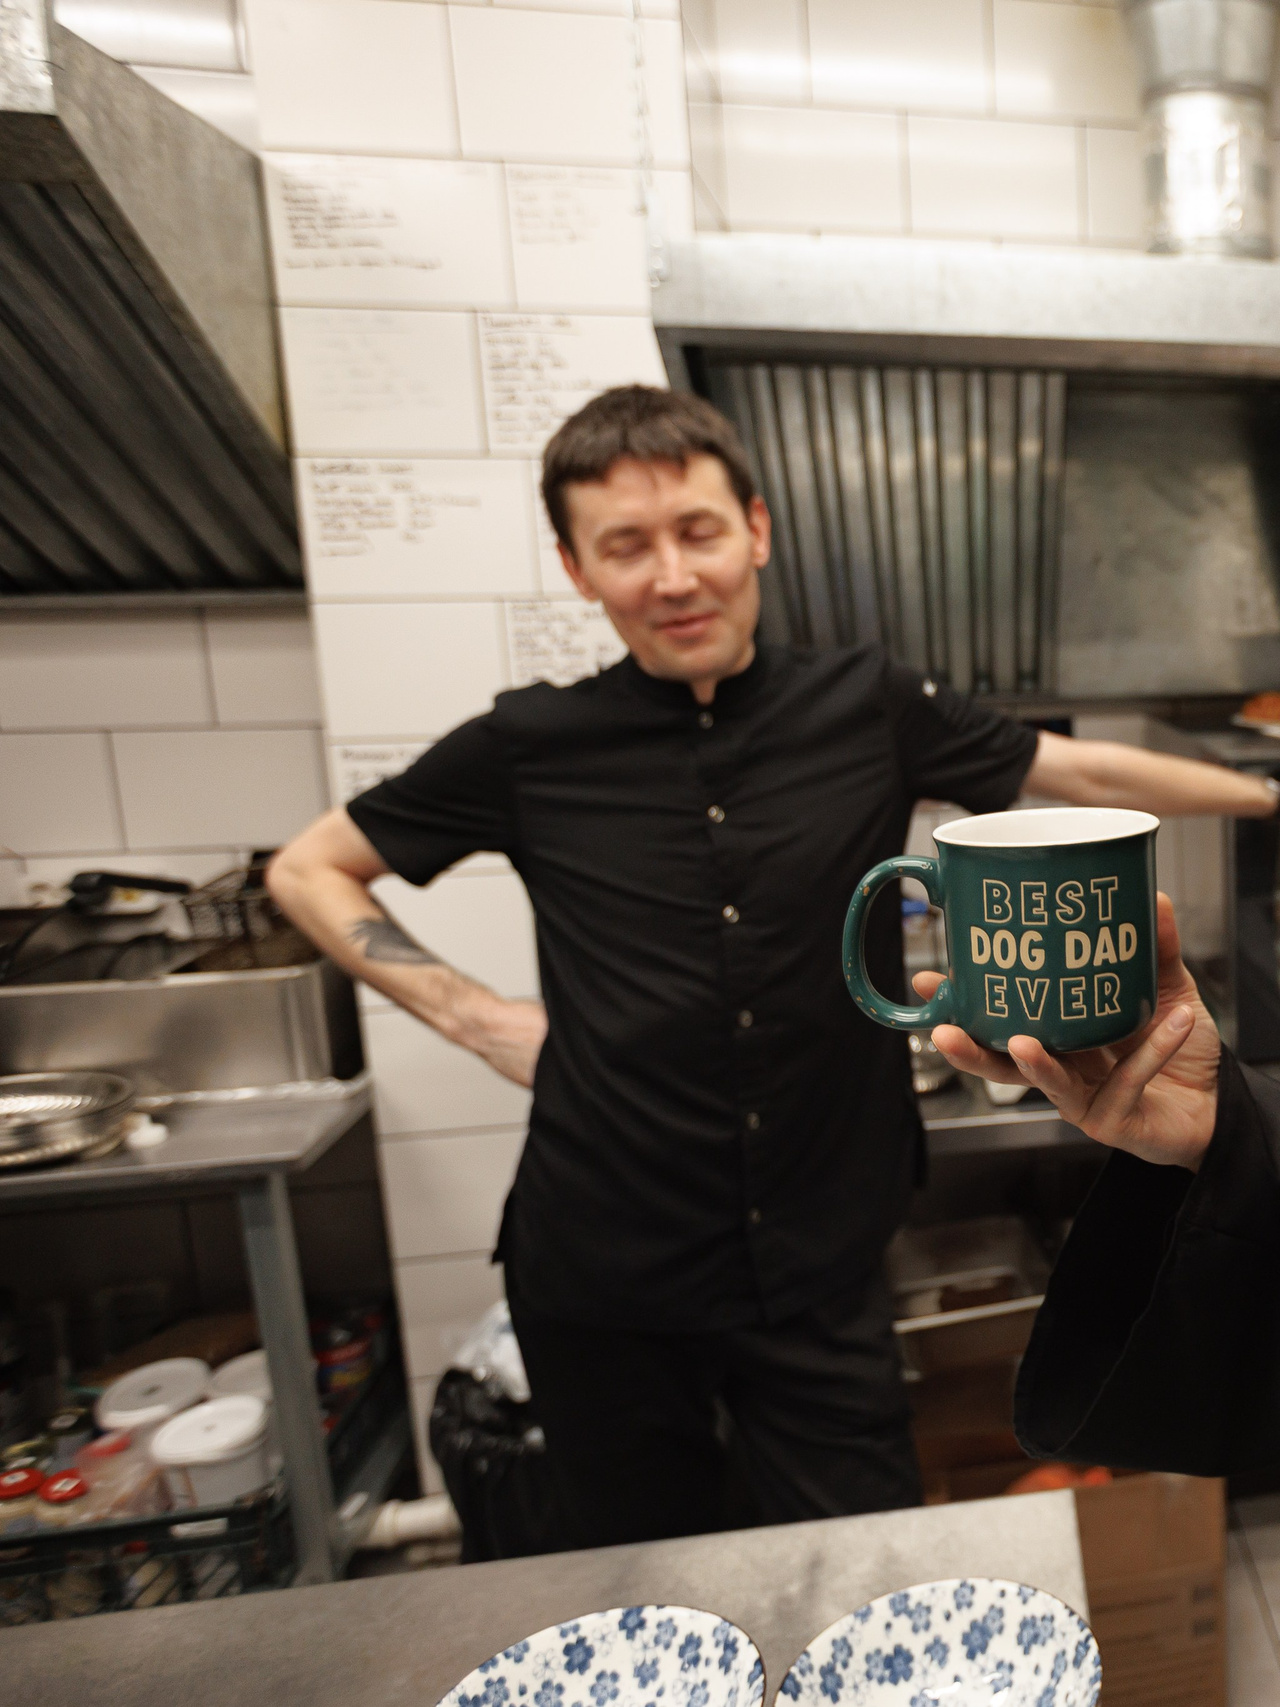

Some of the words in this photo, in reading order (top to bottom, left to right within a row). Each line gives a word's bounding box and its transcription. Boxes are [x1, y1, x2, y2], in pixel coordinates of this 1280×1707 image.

[982, 876, 1118, 925] BEST
[970, 926, 1046, 971] DOG
[1065, 923, 1137, 969] DAD
[985, 973, 1121, 1020] EVER
